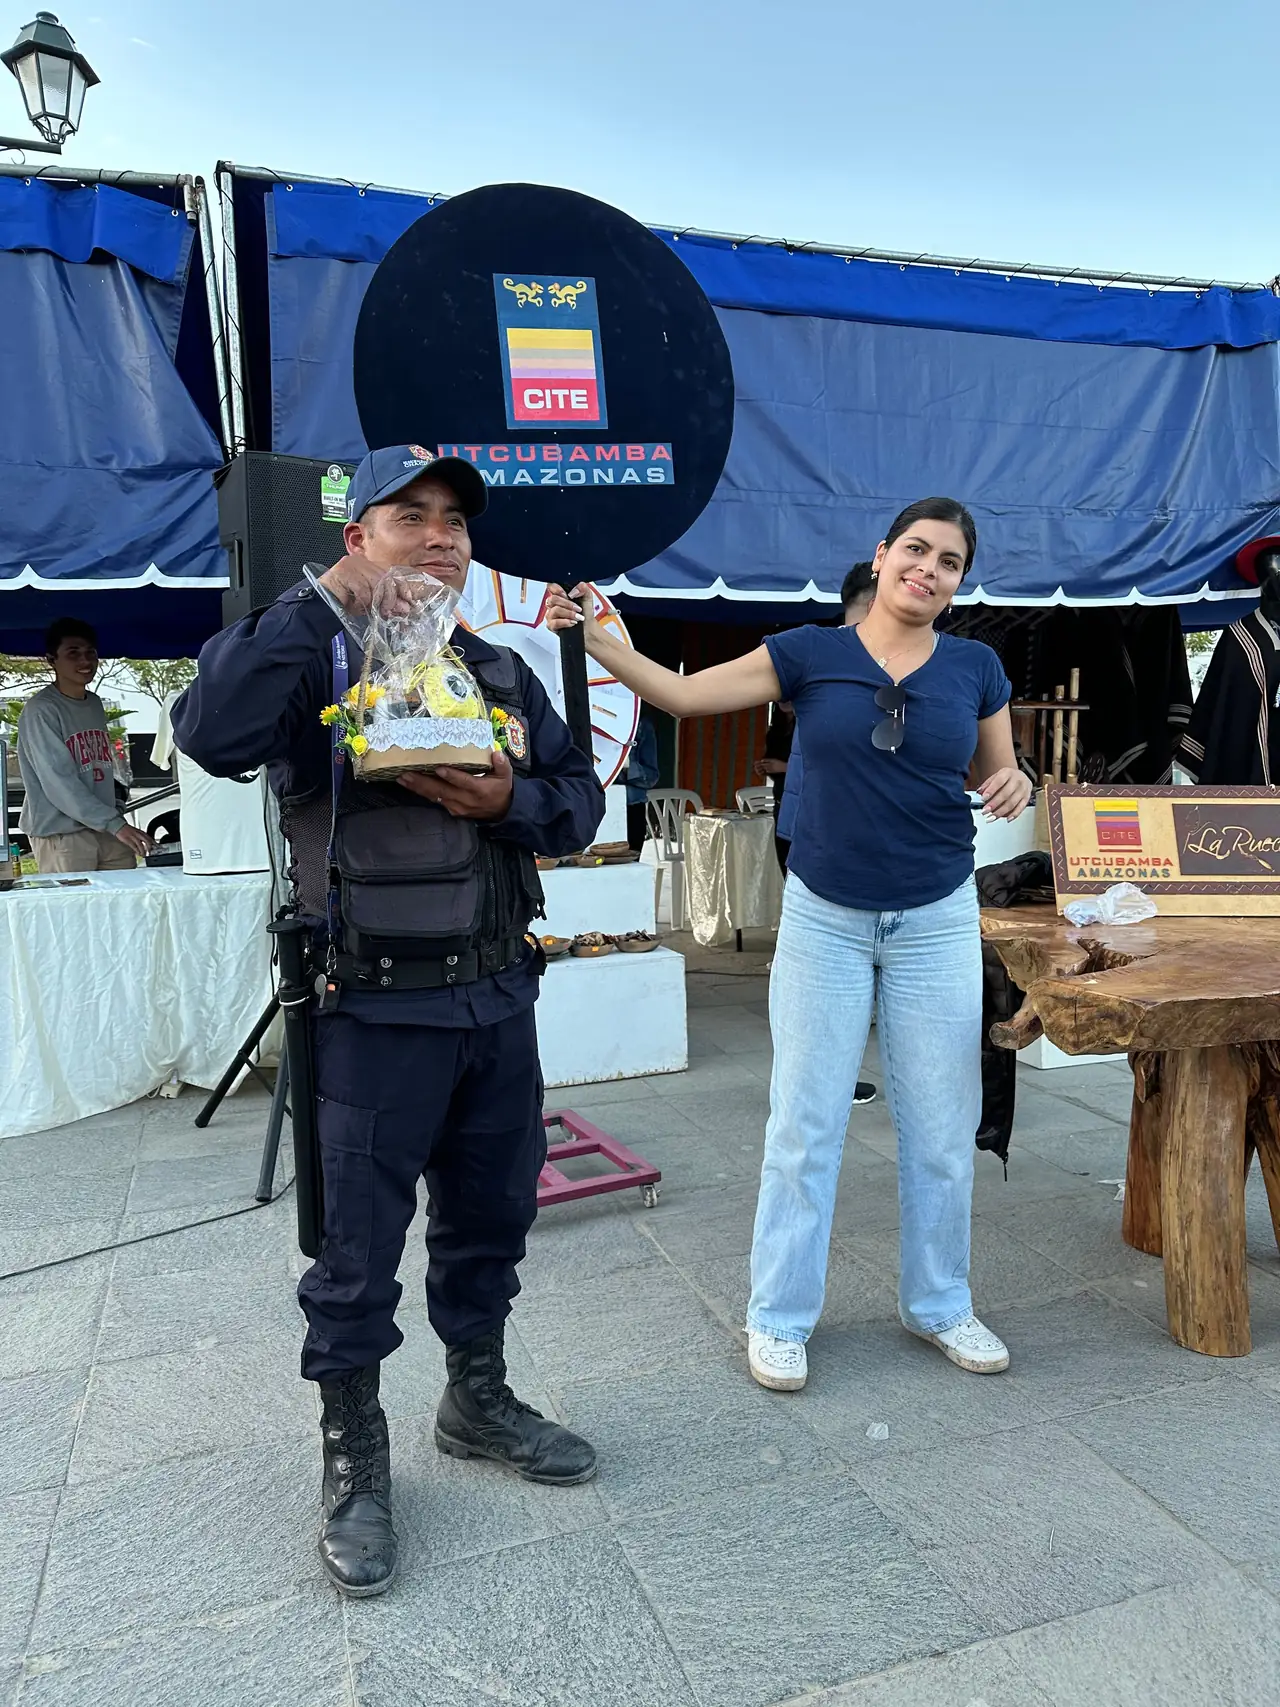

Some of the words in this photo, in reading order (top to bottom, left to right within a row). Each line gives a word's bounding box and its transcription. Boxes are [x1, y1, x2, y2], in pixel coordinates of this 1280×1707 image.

[523, 388, 589, 410] CITE
[437, 445, 672, 462] UTCUBAMBA
[479, 467, 666, 485] MAZONAS
[1101, 831, 1136, 840] CITE
[1187, 827, 1230, 860] La
[1070, 856, 1174, 867] UTCUBAMBA
[1077, 867, 1171, 878] AMAZONAS
